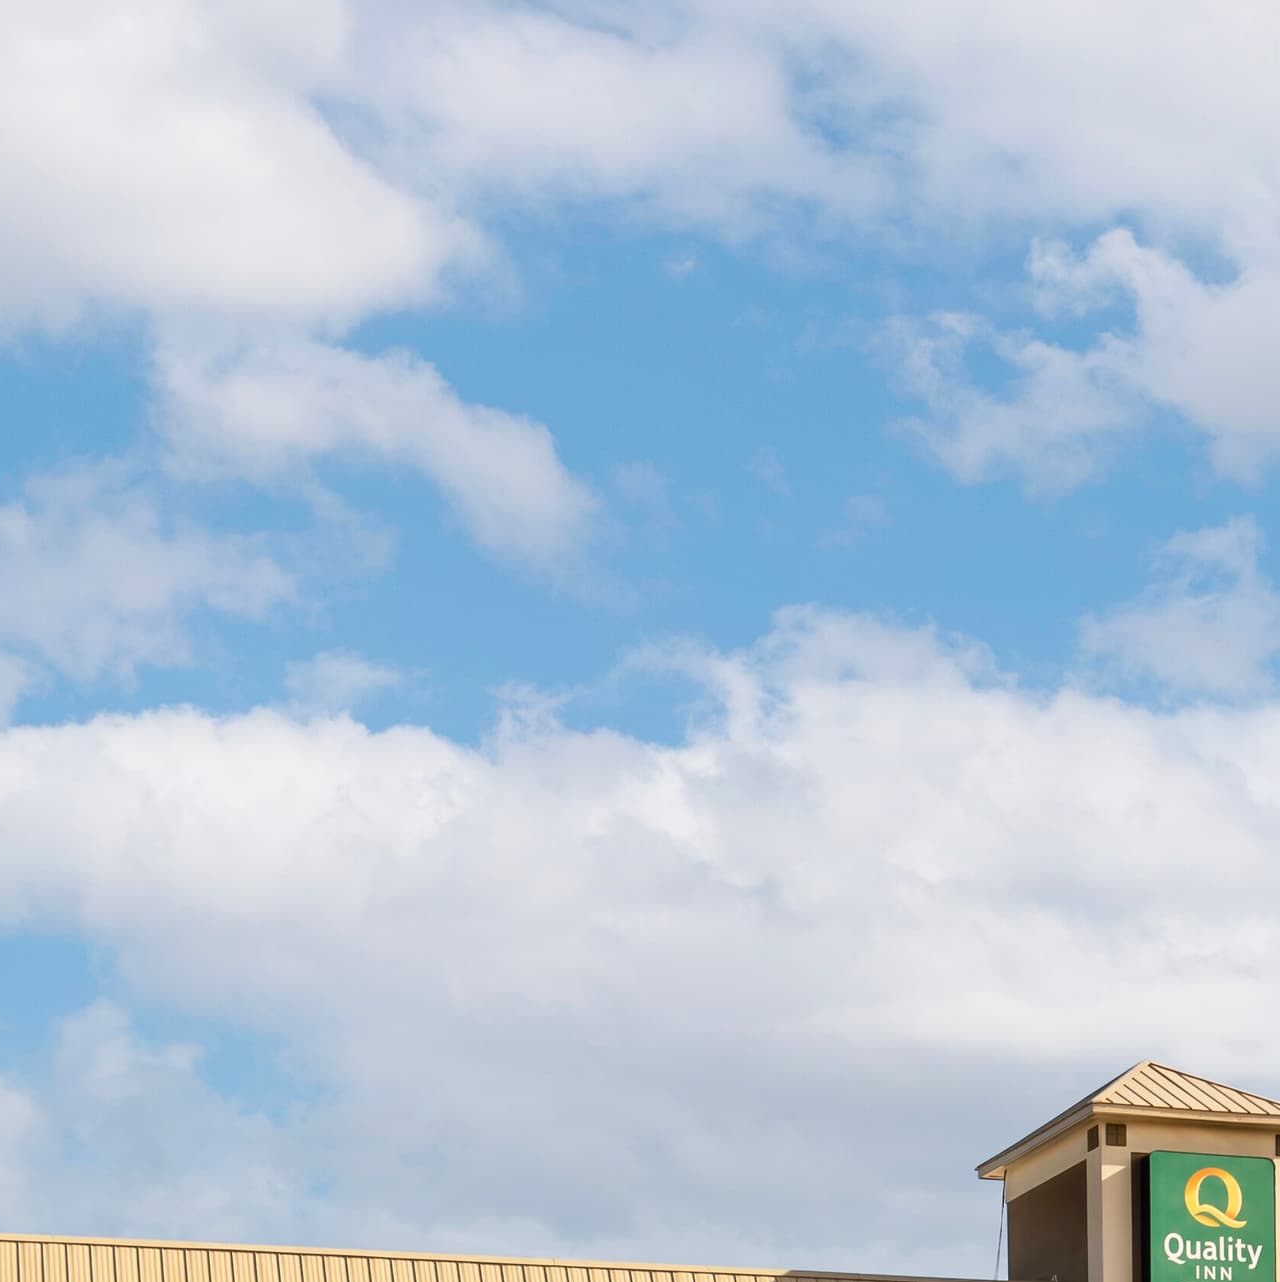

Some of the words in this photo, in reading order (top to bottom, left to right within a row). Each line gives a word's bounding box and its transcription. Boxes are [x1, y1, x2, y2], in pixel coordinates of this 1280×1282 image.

[1184, 1167, 1248, 1229] Q
[1164, 1232, 1263, 1270] Quality
[1195, 1265, 1233, 1281] INN
